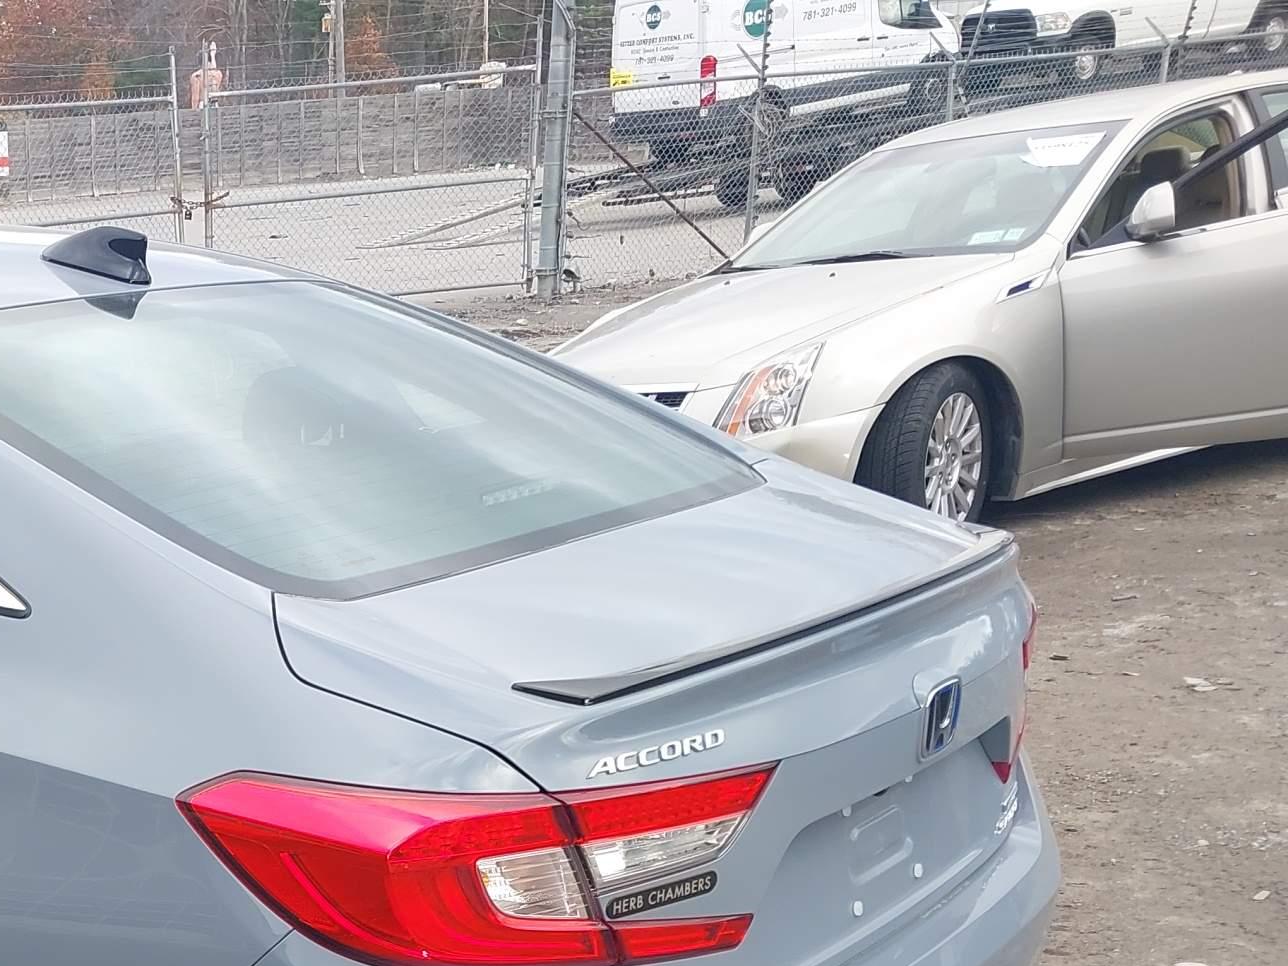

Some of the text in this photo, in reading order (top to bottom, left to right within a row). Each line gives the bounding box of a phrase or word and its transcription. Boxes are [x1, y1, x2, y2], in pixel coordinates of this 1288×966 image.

[646, 12, 662, 23] BCS
[586, 728, 725, 779] ACCORD
[612, 876, 712, 915] HERB CHAMBERS
